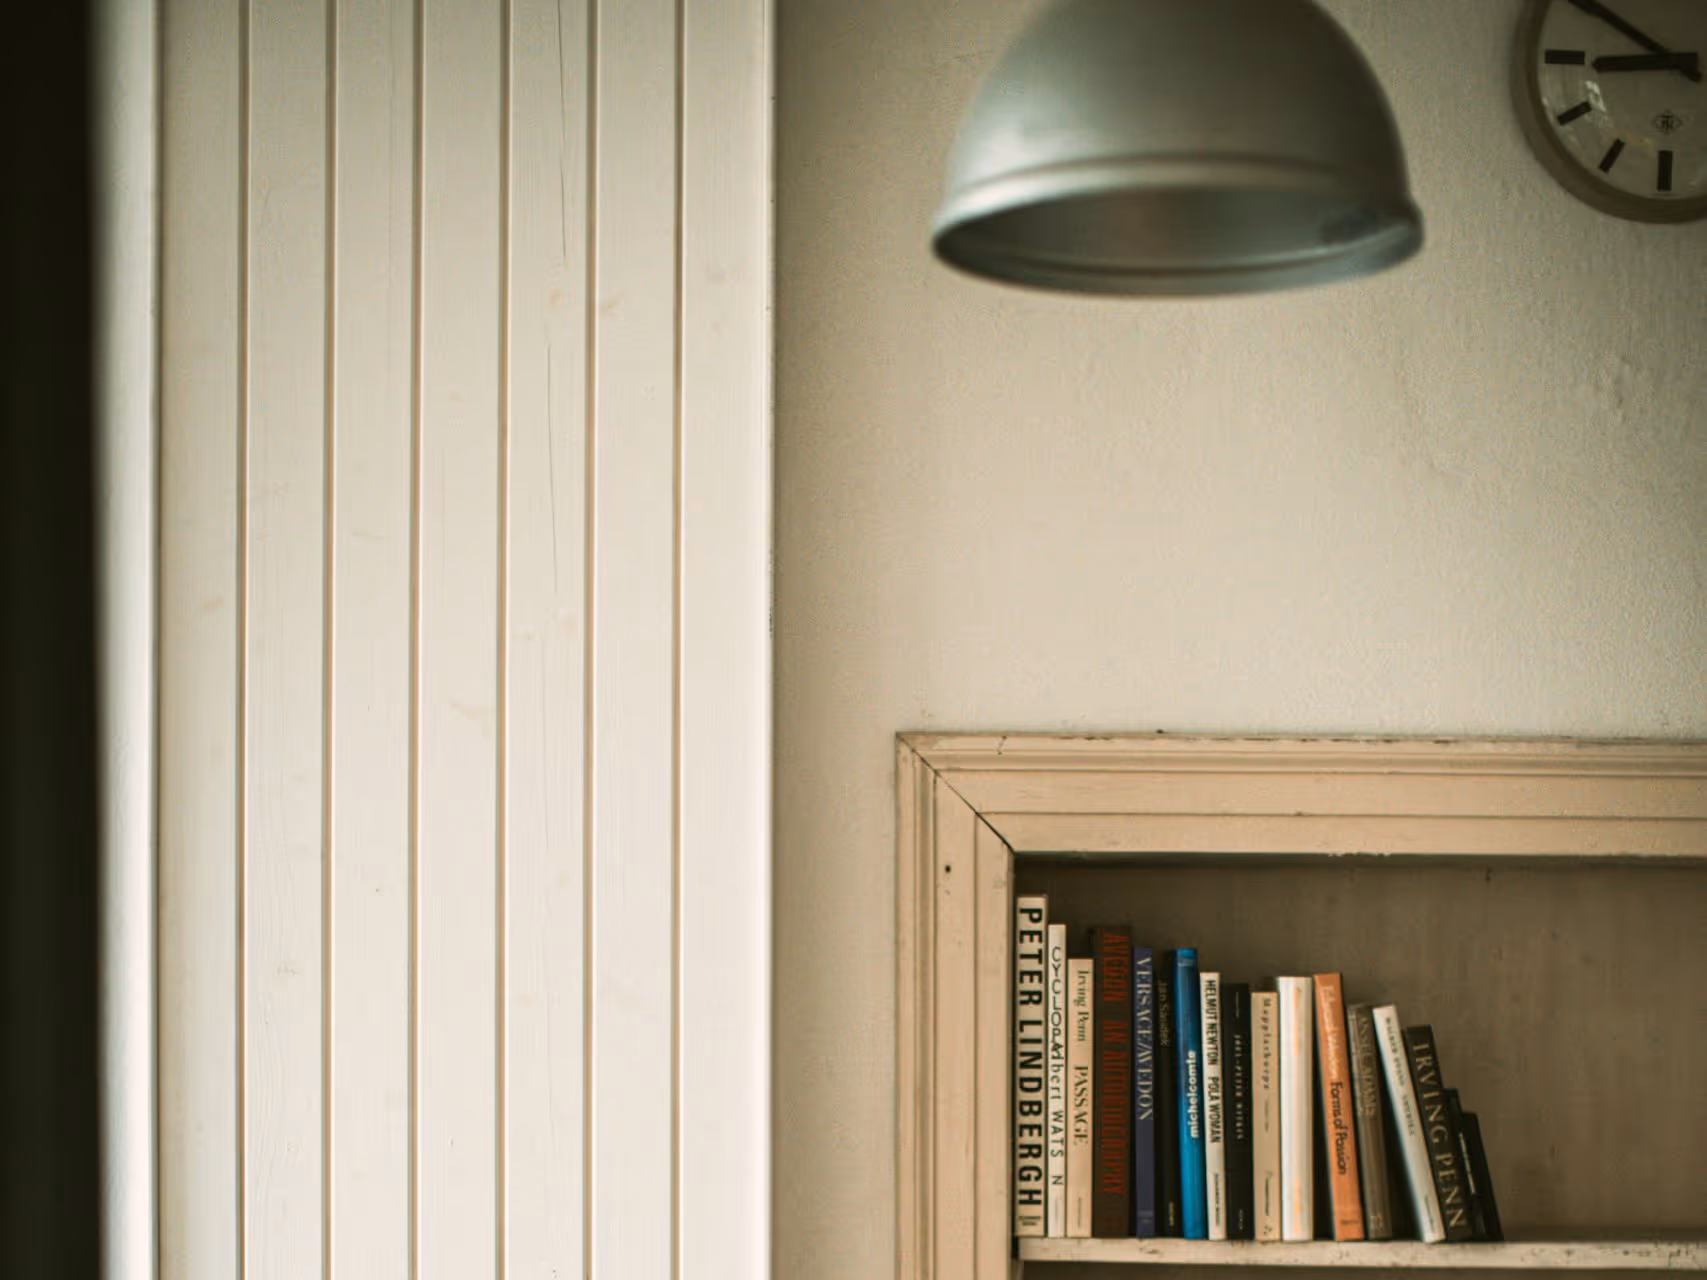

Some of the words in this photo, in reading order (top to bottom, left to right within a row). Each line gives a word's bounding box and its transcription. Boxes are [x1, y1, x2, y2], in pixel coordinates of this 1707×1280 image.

[1019, 907, 1042, 1005] PETER
[1103, 934, 1128, 1002] AVEDON
[1074, 969, 1089, 1007] Irving
[1205, 979, 1217, 1020] HELMUT
[1077, 1011, 1089, 1042] Penn
[1103, 1020, 1127, 1044] AN
[1137, 956, 1153, 1121] VERSACE/AVEDON
[1206, 1022, 1219, 1065] NEWTON
[1073, 1065, 1089, 1145] PASSAGE
[1187, 1050, 1199, 1138] michelcomte
[1208, 1076, 1220, 1101] POLA
[1331, 1081, 1344, 1119] Forms
[1019, 1019, 1042, 1205] LINDBERGH
[1101, 1050, 1127, 1195] AUTOBIOGRAPHY
[1209, 1104, 1222, 1143] WOMAN
[1333, 1119, 1347, 1131] of
[1336, 1132, 1349, 1175] Passion
[1412, 1043, 1449, 1144] IRVING
[1436, 1152, 1466, 1228] PENN
